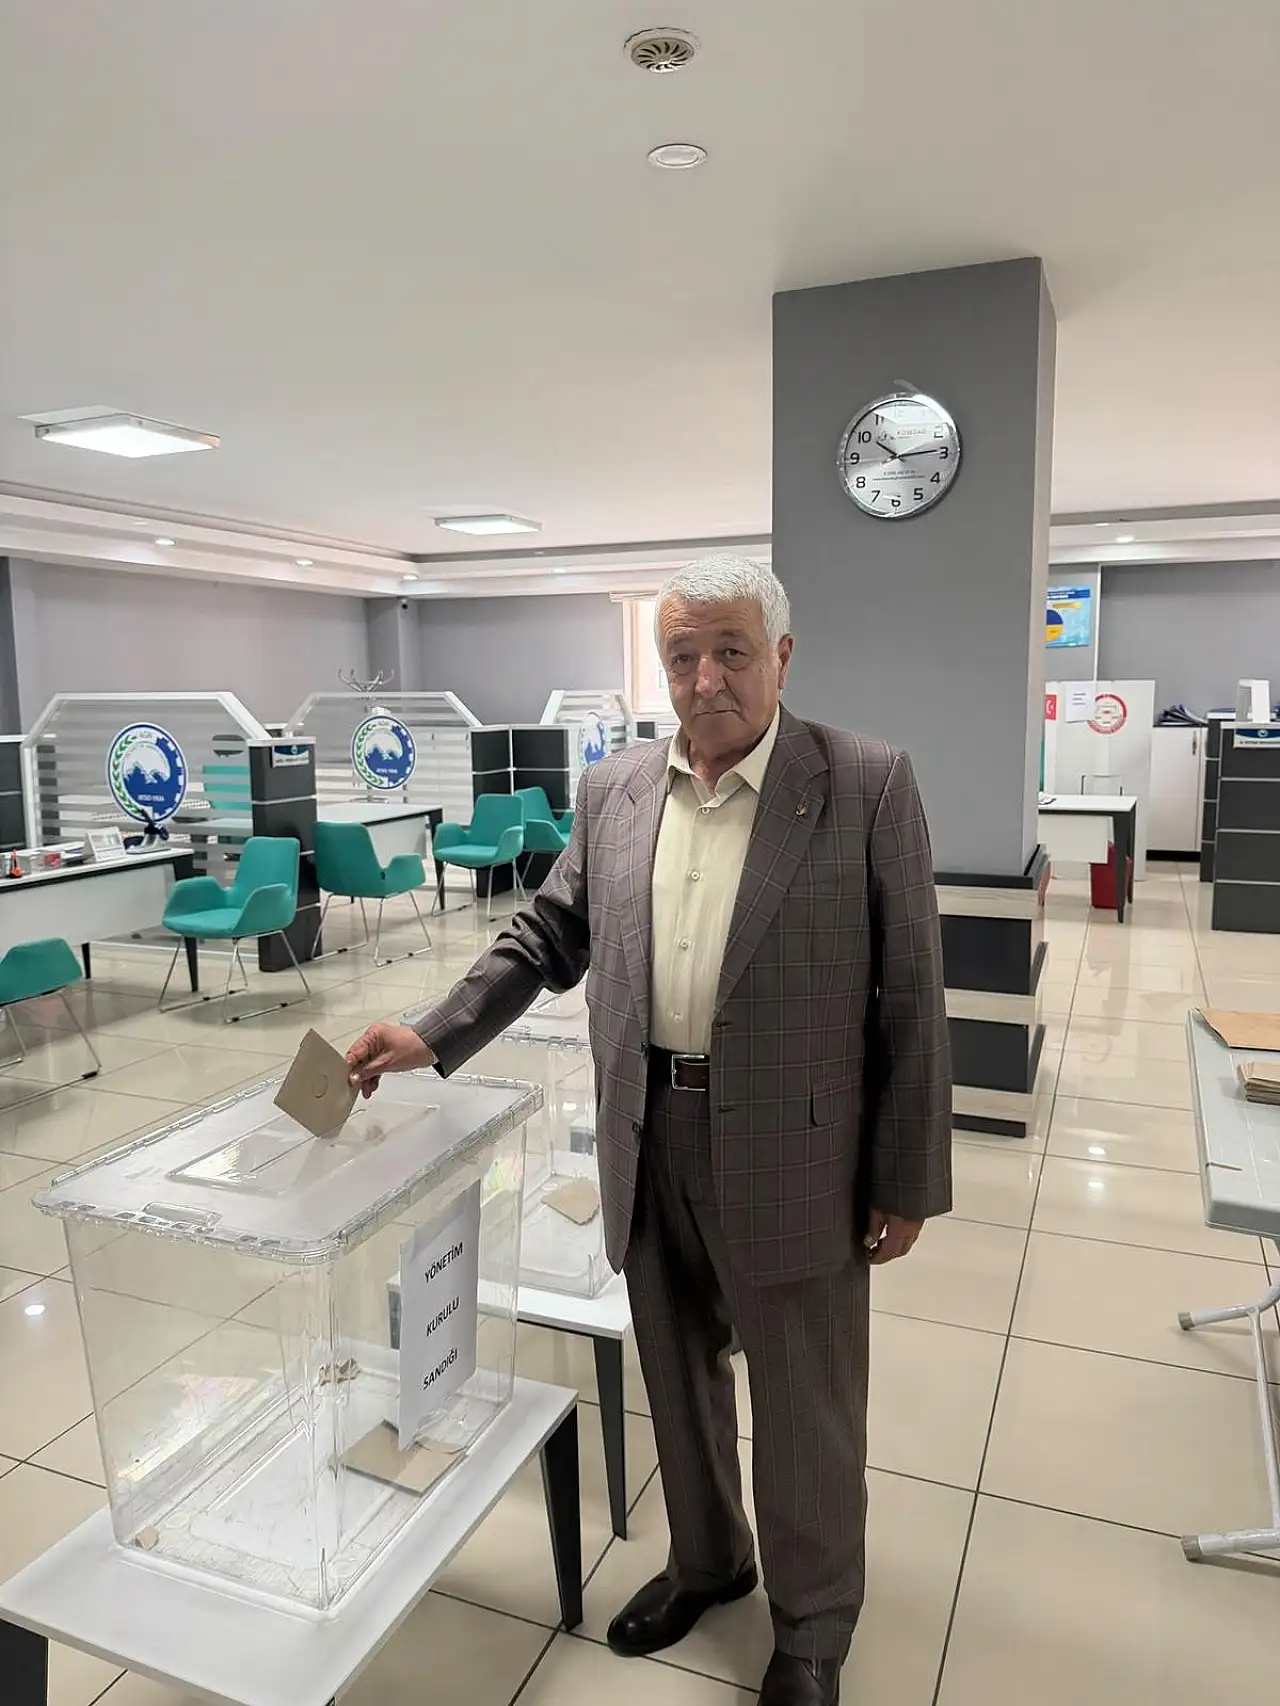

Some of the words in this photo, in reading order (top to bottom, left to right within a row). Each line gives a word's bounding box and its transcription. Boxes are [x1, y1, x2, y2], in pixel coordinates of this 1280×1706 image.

[858, 431, 872, 444] 10
[850, 452, 860, 465] 9
[938, 446, 949, 460] 3
[856, 476, 866, 489] 8
[930, 472, 941, 484] 4
[871, 490, 881, 503] 7
[913, 488, 924, 501] 5
[424, 1242, 463, 1283] YÖNETİM
[426, 1297, 460, 1337] KURULU
[423, 1348, 458, 1390] SANDIĞI
